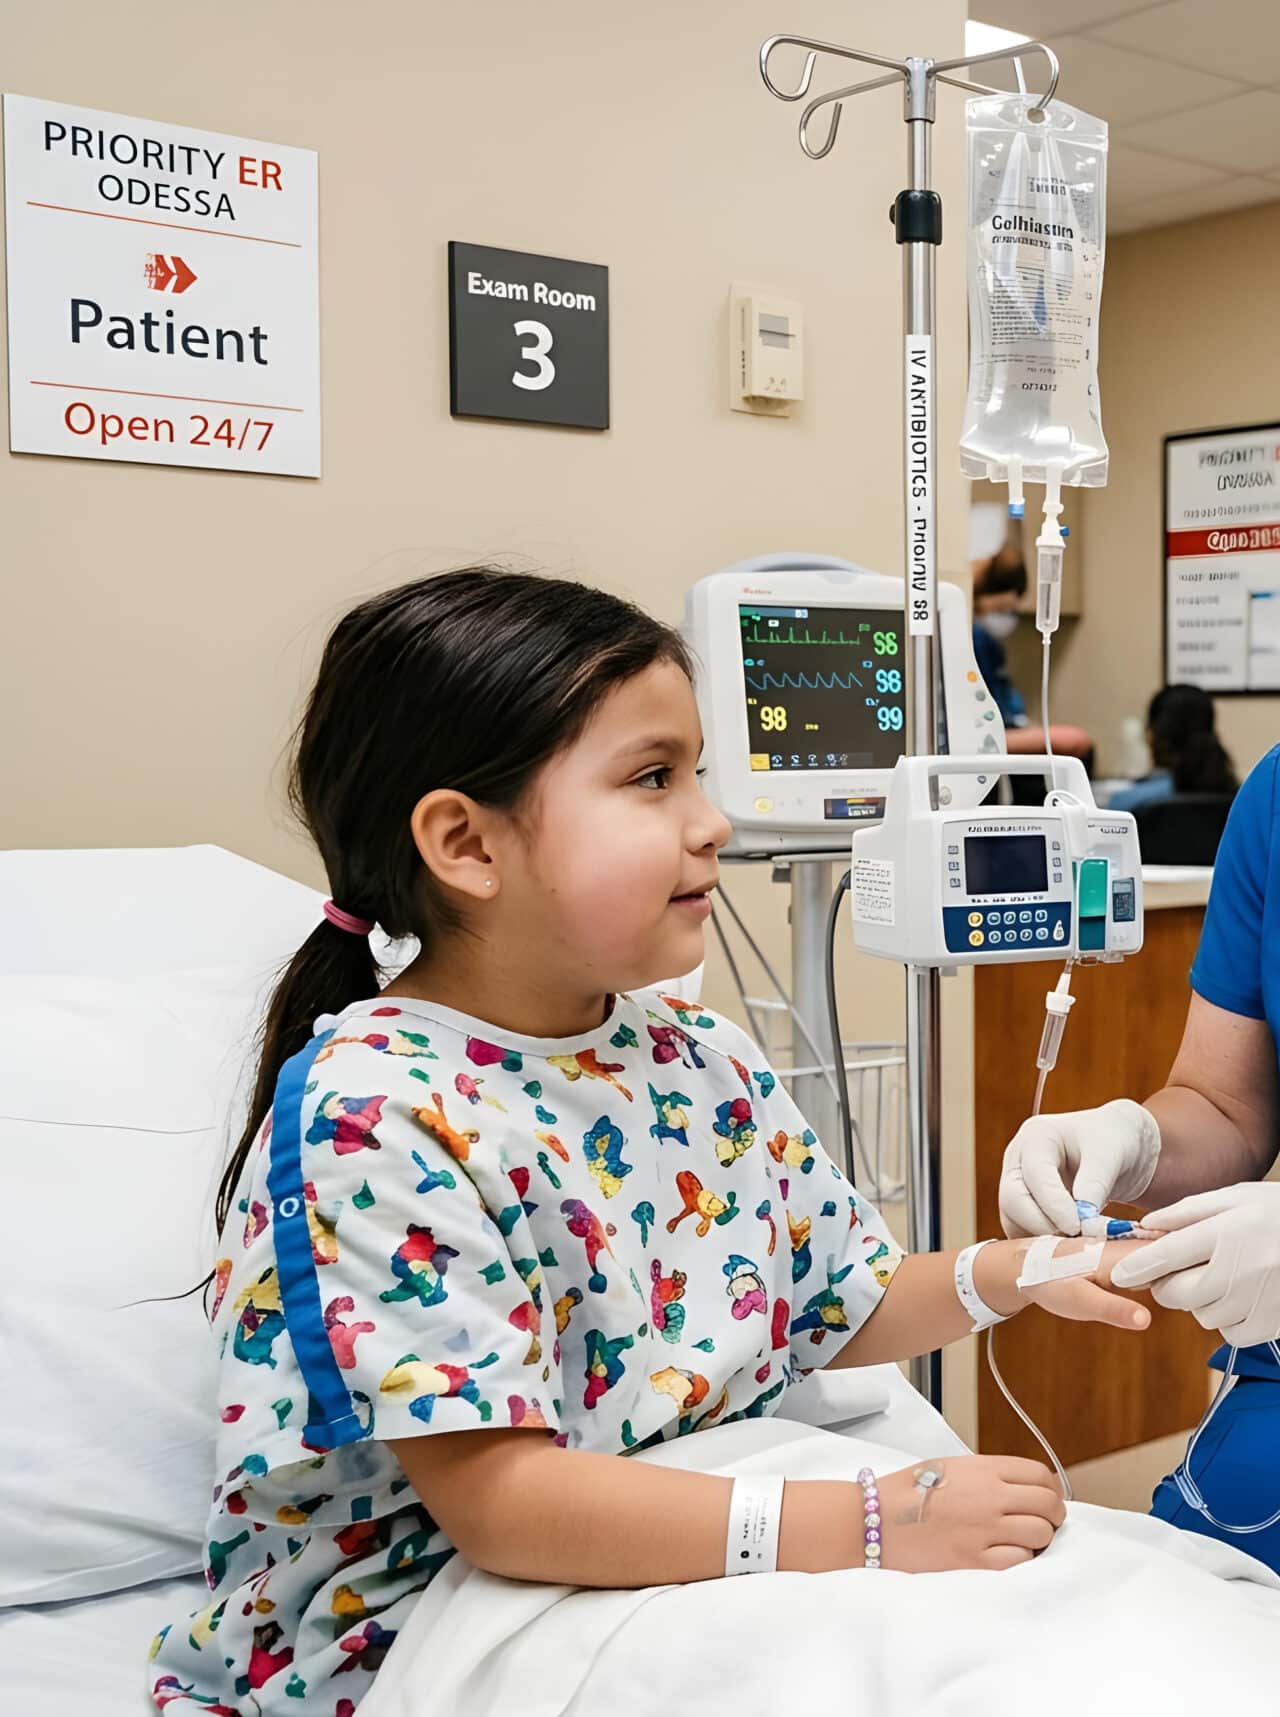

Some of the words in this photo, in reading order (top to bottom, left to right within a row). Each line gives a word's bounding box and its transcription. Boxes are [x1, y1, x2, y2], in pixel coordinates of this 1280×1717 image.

[44, 120, 226, 180] PRIORITY
[238, 155, 283, 191] ER
[98, 173, 236, 221] ODESSA
[468, 271, 528, 302] Exam
[534, 281, 596, 311] Room
[70, 298, 269, 365] Patient
[512, 319, 556, 391] 3
[911, 350, 927, 368] IV
[64, 402, 175, 446] Open
[189, 413, 275, 452] 24/7
[760, 706, 788, 732] 98
[877, 706, 904, 732] 99
